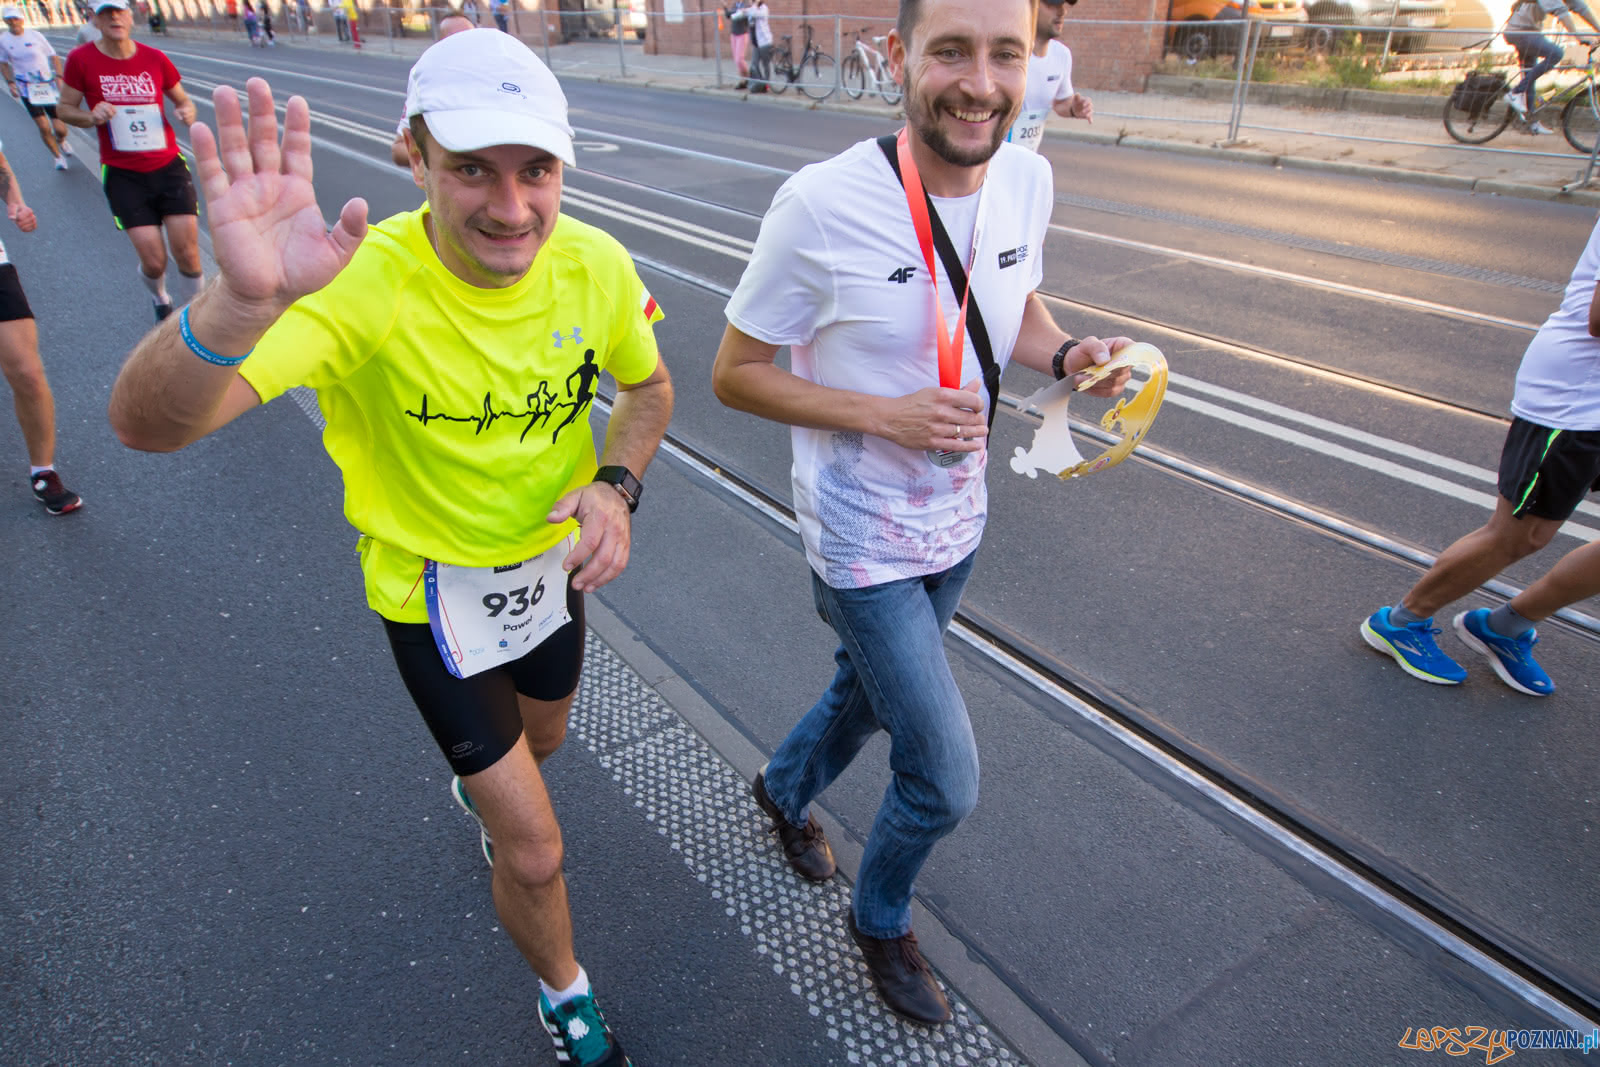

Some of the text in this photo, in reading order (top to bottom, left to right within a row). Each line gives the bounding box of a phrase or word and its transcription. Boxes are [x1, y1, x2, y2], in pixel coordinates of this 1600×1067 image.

[101, 82, 155, 96] SZPIKU
[129, 121, 147, 132] 63
[888, 267, 917, 283] 4F
[482, 575, 545, 618] 936
